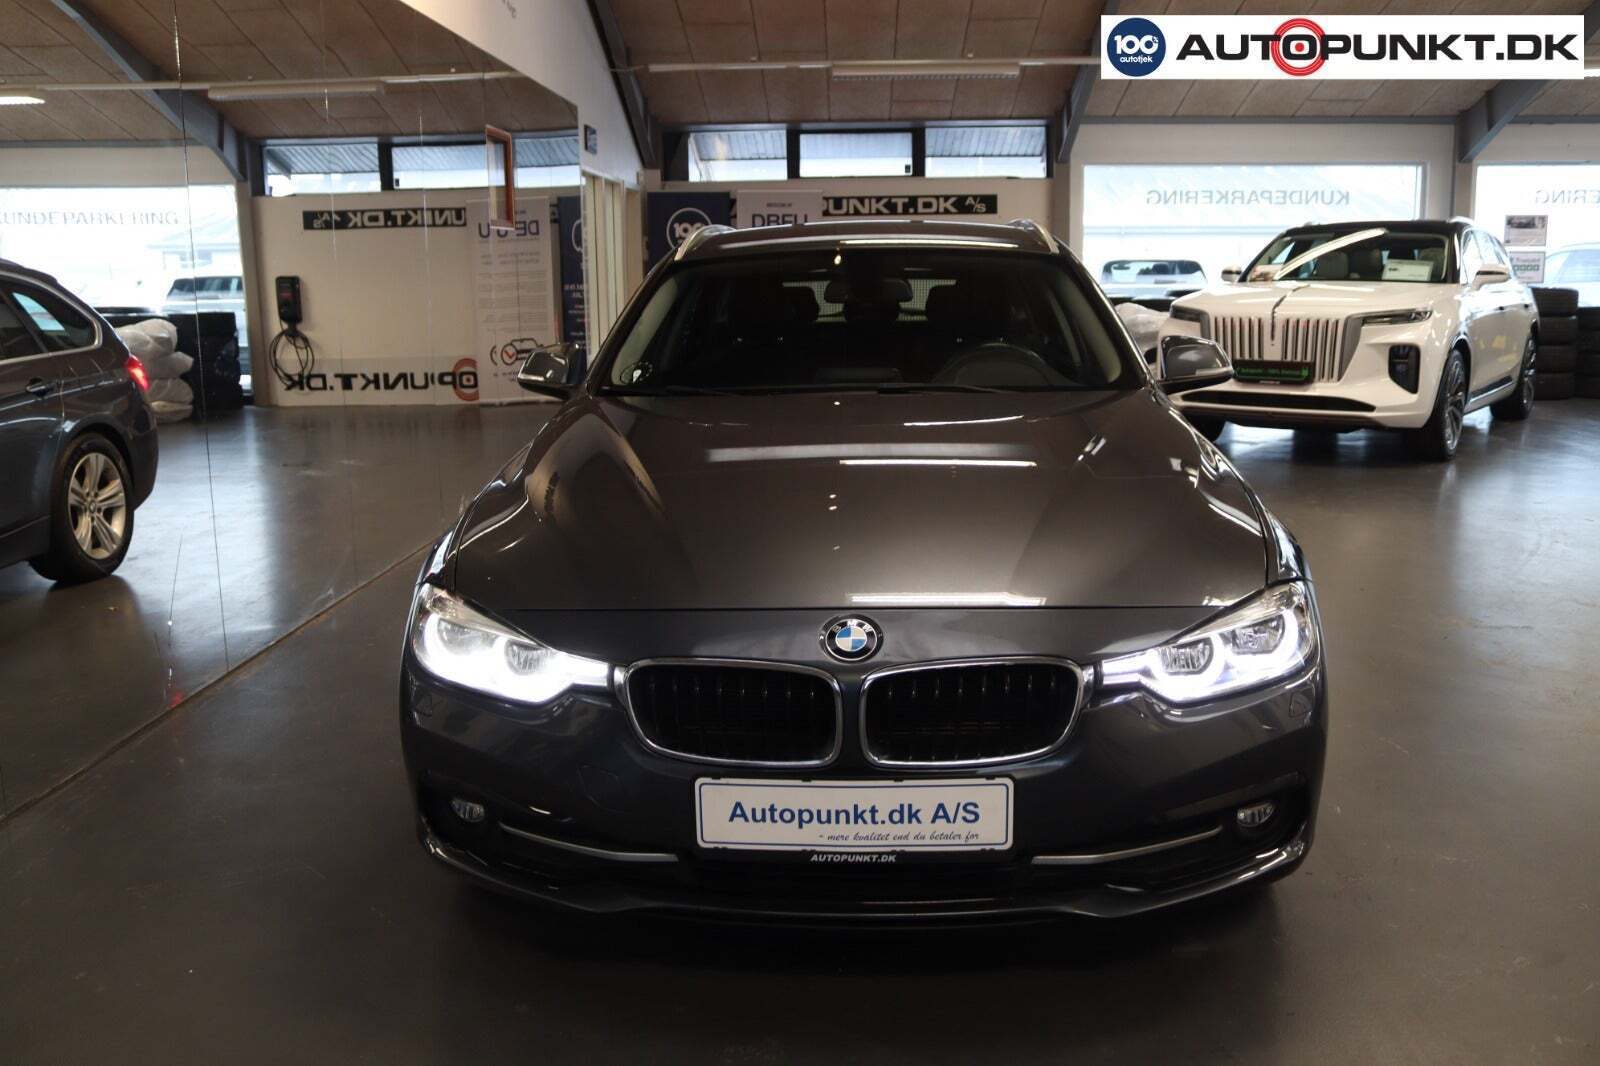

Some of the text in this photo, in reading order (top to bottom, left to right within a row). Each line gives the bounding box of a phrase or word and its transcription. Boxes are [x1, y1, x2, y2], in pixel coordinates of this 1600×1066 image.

[965, 196, 987, 213] A/S
[728, 801, 980, 829] Autopunkt.dk A/S
[827, 834, 850, 842] mere
[853, 831, 890, 841] kvalitet
[893, 832, 910, 841] end
[913, 832, 926, 841] du
[930, 831, 963, 841] betaler
[964, 832, 980, 844] for
[810, 853, 897, 864] AUTOPUNKT.DK
